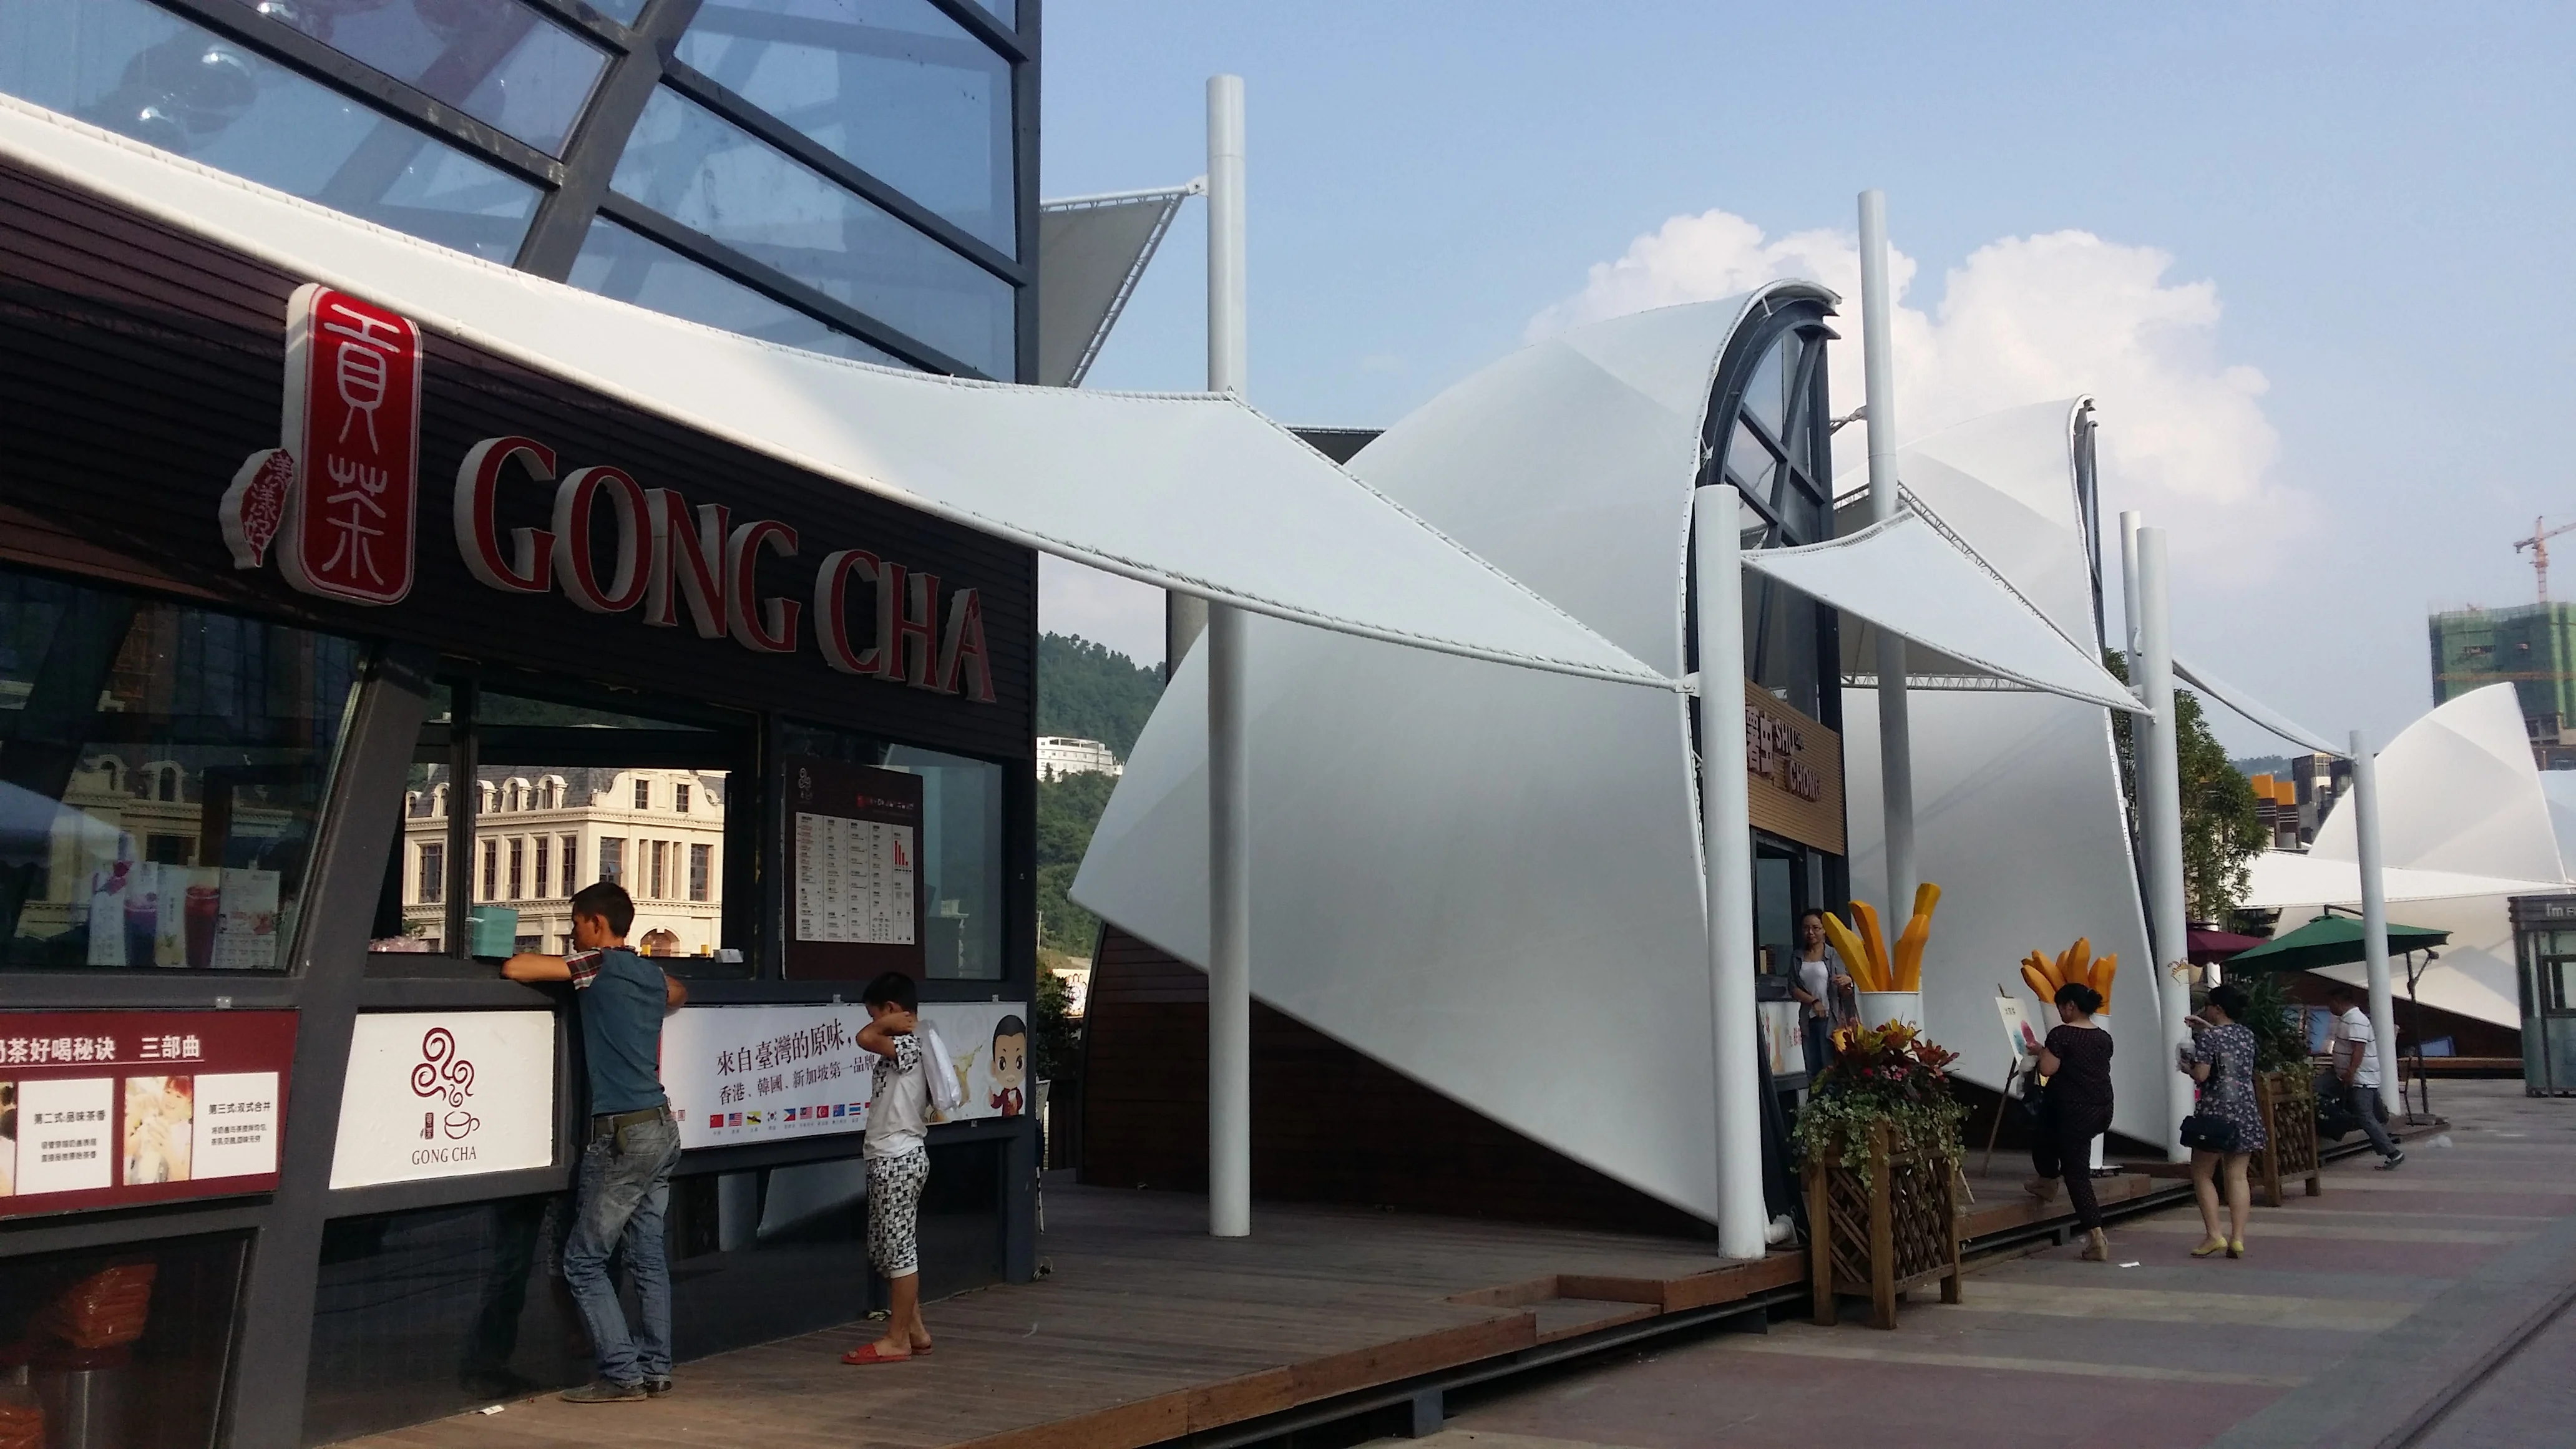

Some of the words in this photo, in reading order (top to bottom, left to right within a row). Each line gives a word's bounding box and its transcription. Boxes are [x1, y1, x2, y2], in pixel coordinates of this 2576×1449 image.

[454, 435, 801, 653] GONG
[814, 549, 998, 703] CHA
[1775, 718, 1795, 755] SHU
[0, 1037, 115, 1063] 茶好喝秘诀
[139, 1035, 200, 1059] 三部曲
[412, 1149, 449, 1165] GONG
[452, 1146, 477, 1162] CHA
